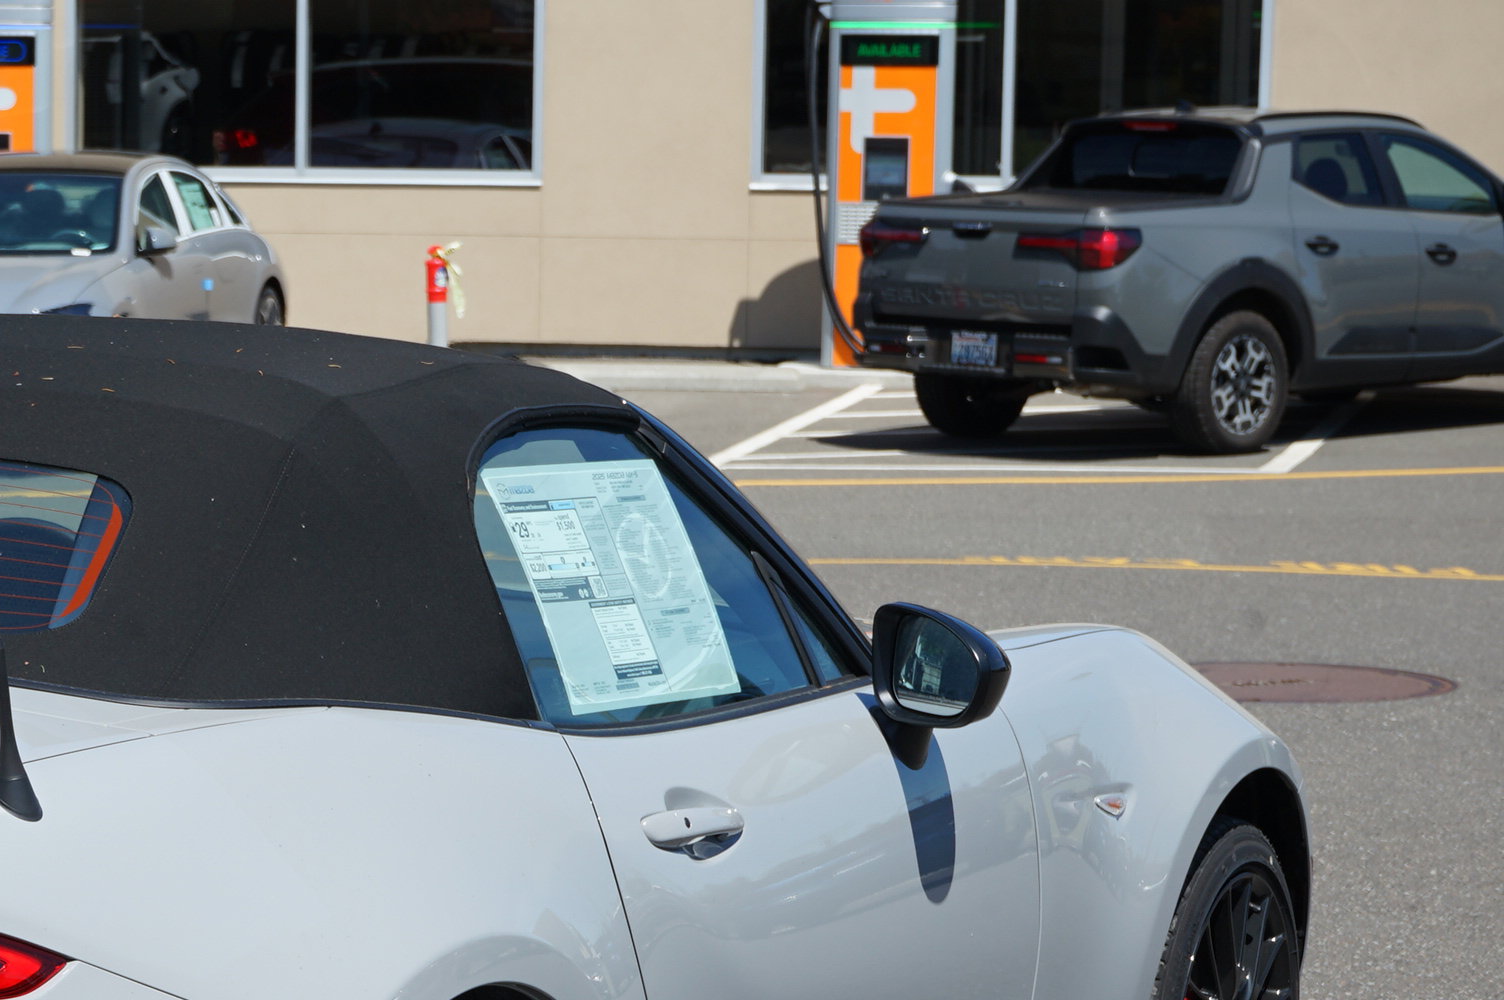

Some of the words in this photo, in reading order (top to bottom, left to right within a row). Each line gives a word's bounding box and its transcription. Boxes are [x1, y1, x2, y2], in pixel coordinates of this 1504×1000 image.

[857, 43, 921, 57] AVAILABLE
[880, 287, 971, 308] SANTA
[979, 290, 1065, 312] CRUZ
[515, 521, 530, 538] 29
